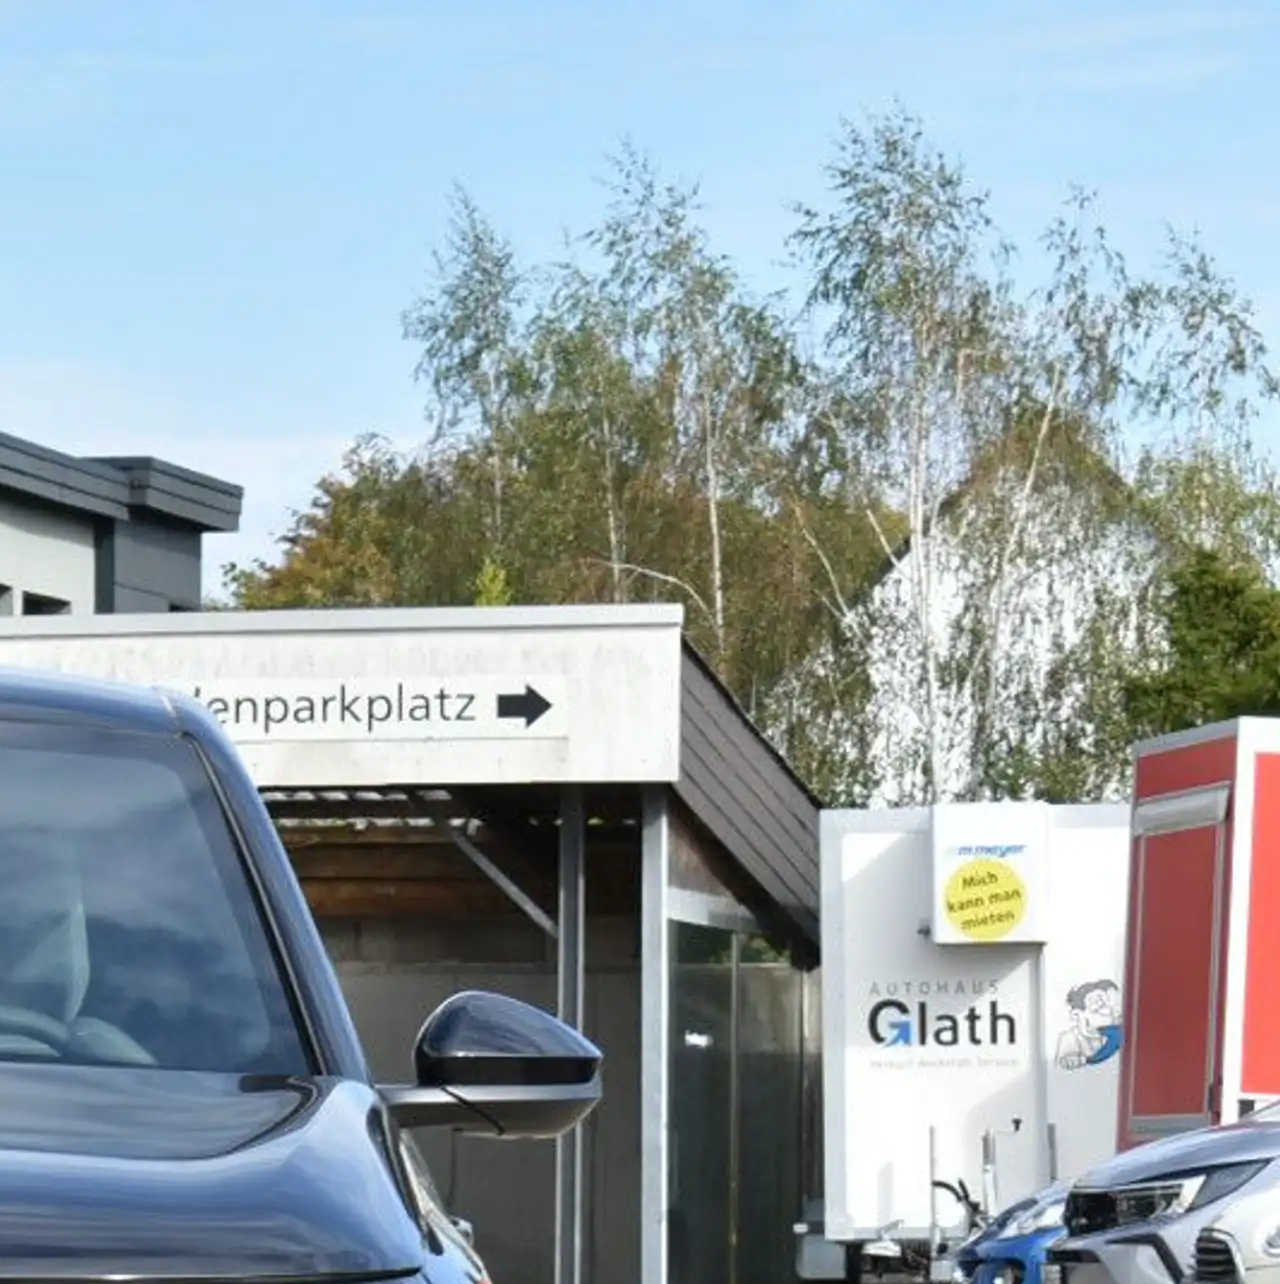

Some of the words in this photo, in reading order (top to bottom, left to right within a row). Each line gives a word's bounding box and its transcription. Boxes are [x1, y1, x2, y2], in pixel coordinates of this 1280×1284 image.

[194, 683, 477, 734] enparkplatz
[962, 871, 998, 890] Mich
[947, 896, 985, 914] kann
[987, 889, 1022, 905] man
[961, 910, 1016, 930] mieten
[868, 979, 1000, 997] AUTOHAUS
[868, 998, 1016, 1047] Glath
